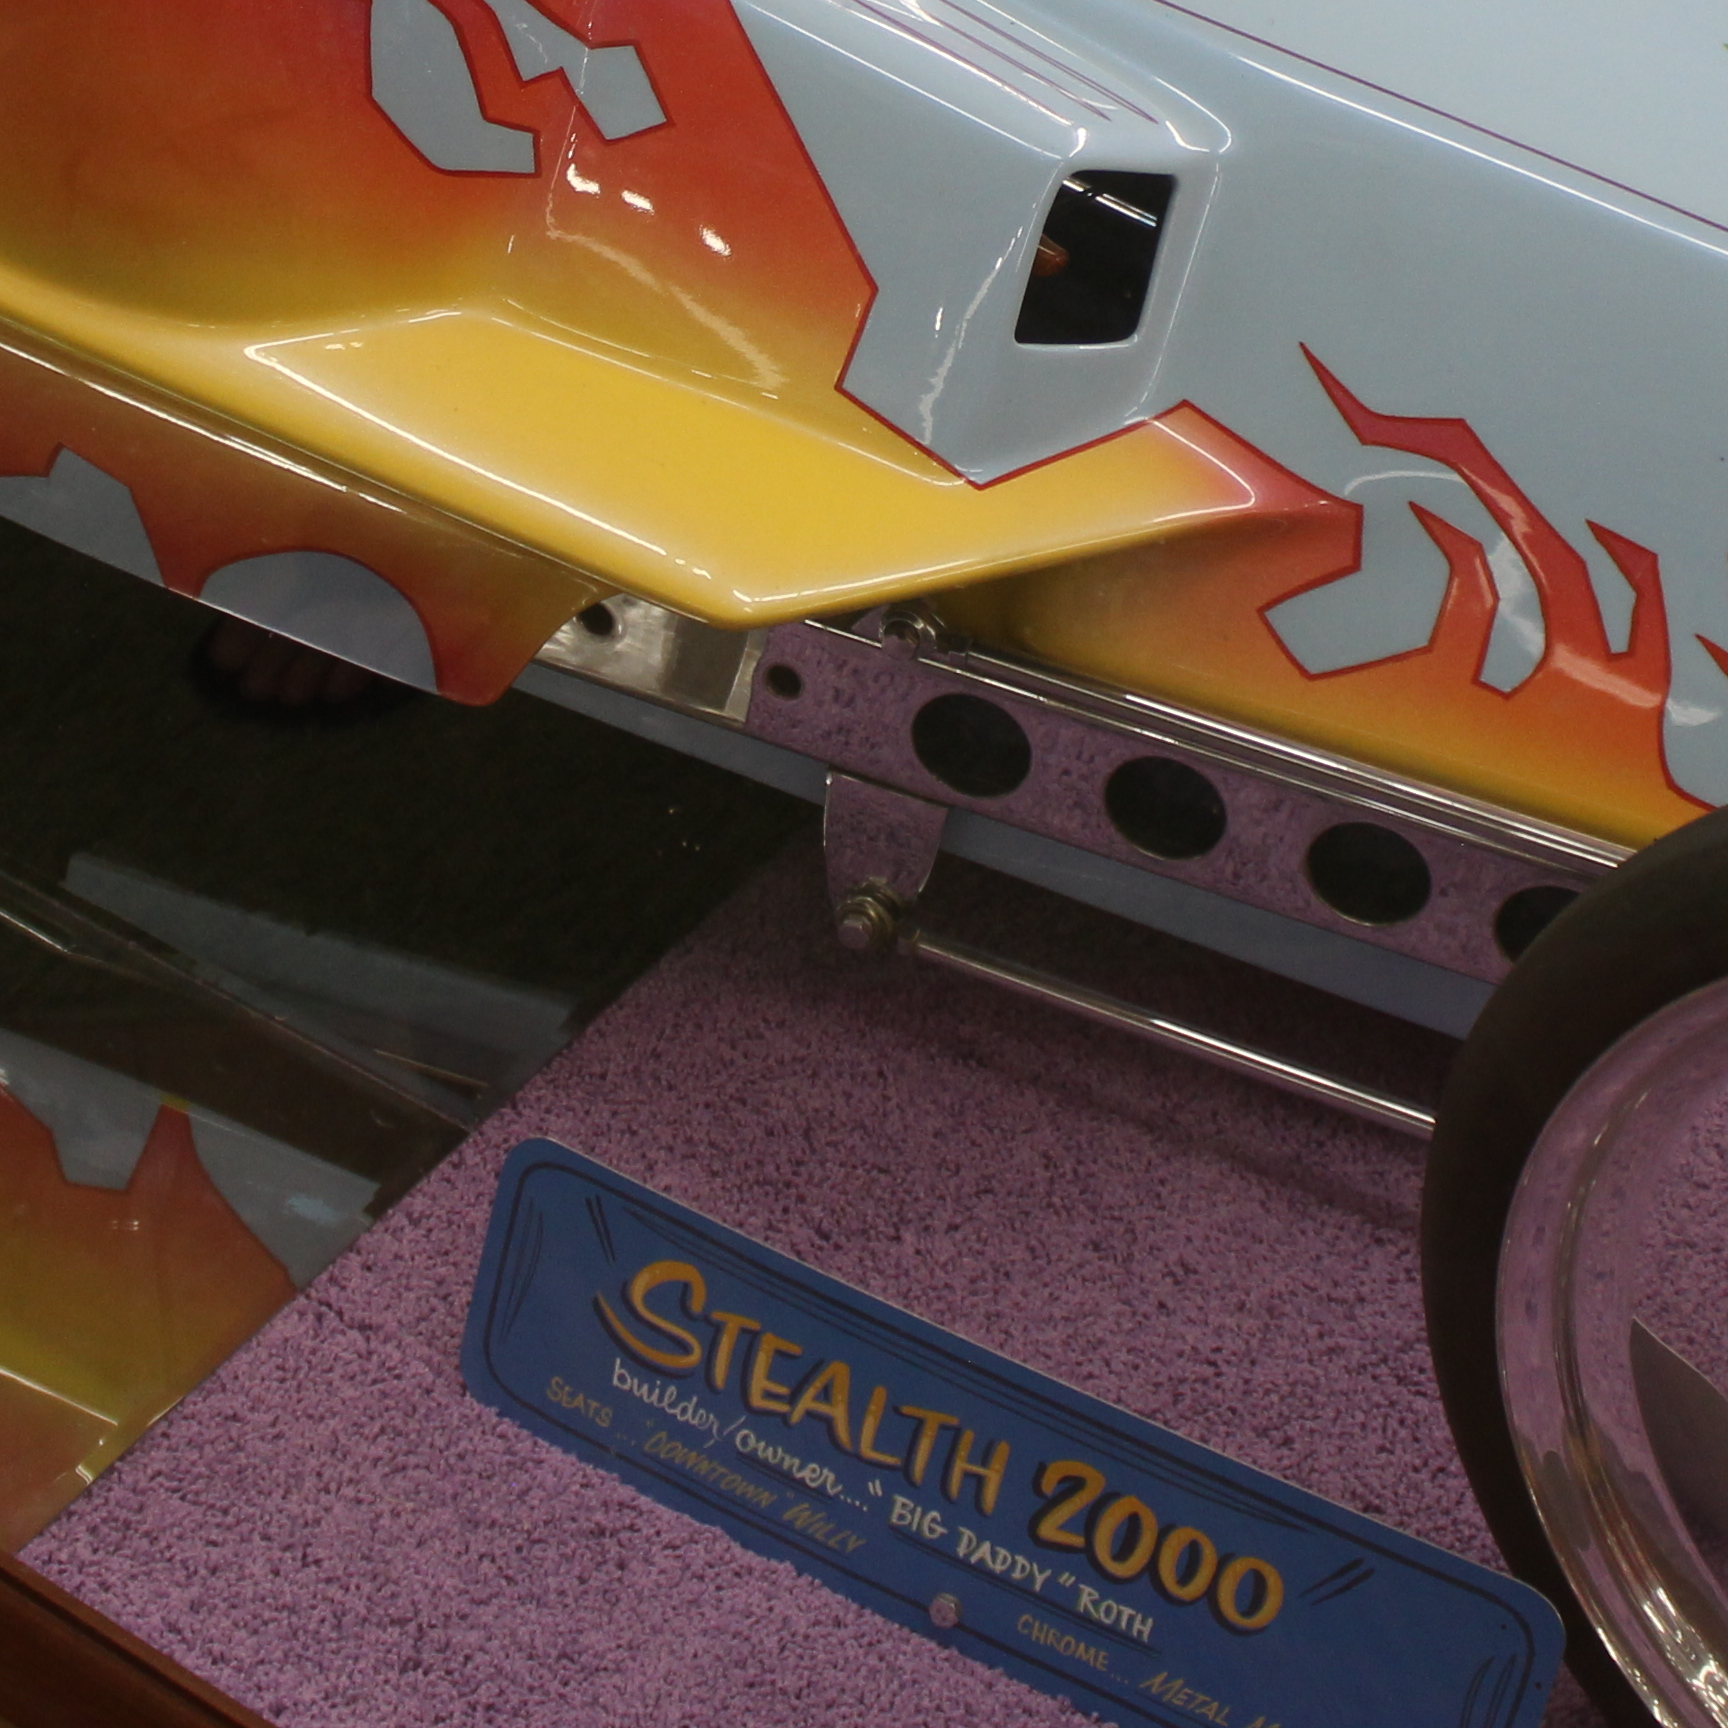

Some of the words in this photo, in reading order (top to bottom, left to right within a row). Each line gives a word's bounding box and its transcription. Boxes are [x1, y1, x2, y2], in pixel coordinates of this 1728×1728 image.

[594, 1259, 1012, 1517] STEALTH
[1030, 1458, 1286, 1633] 2000
[1078, 1583, 1155, 1643] ROTH
[1139, 1671, 1232, 1728] METAL
